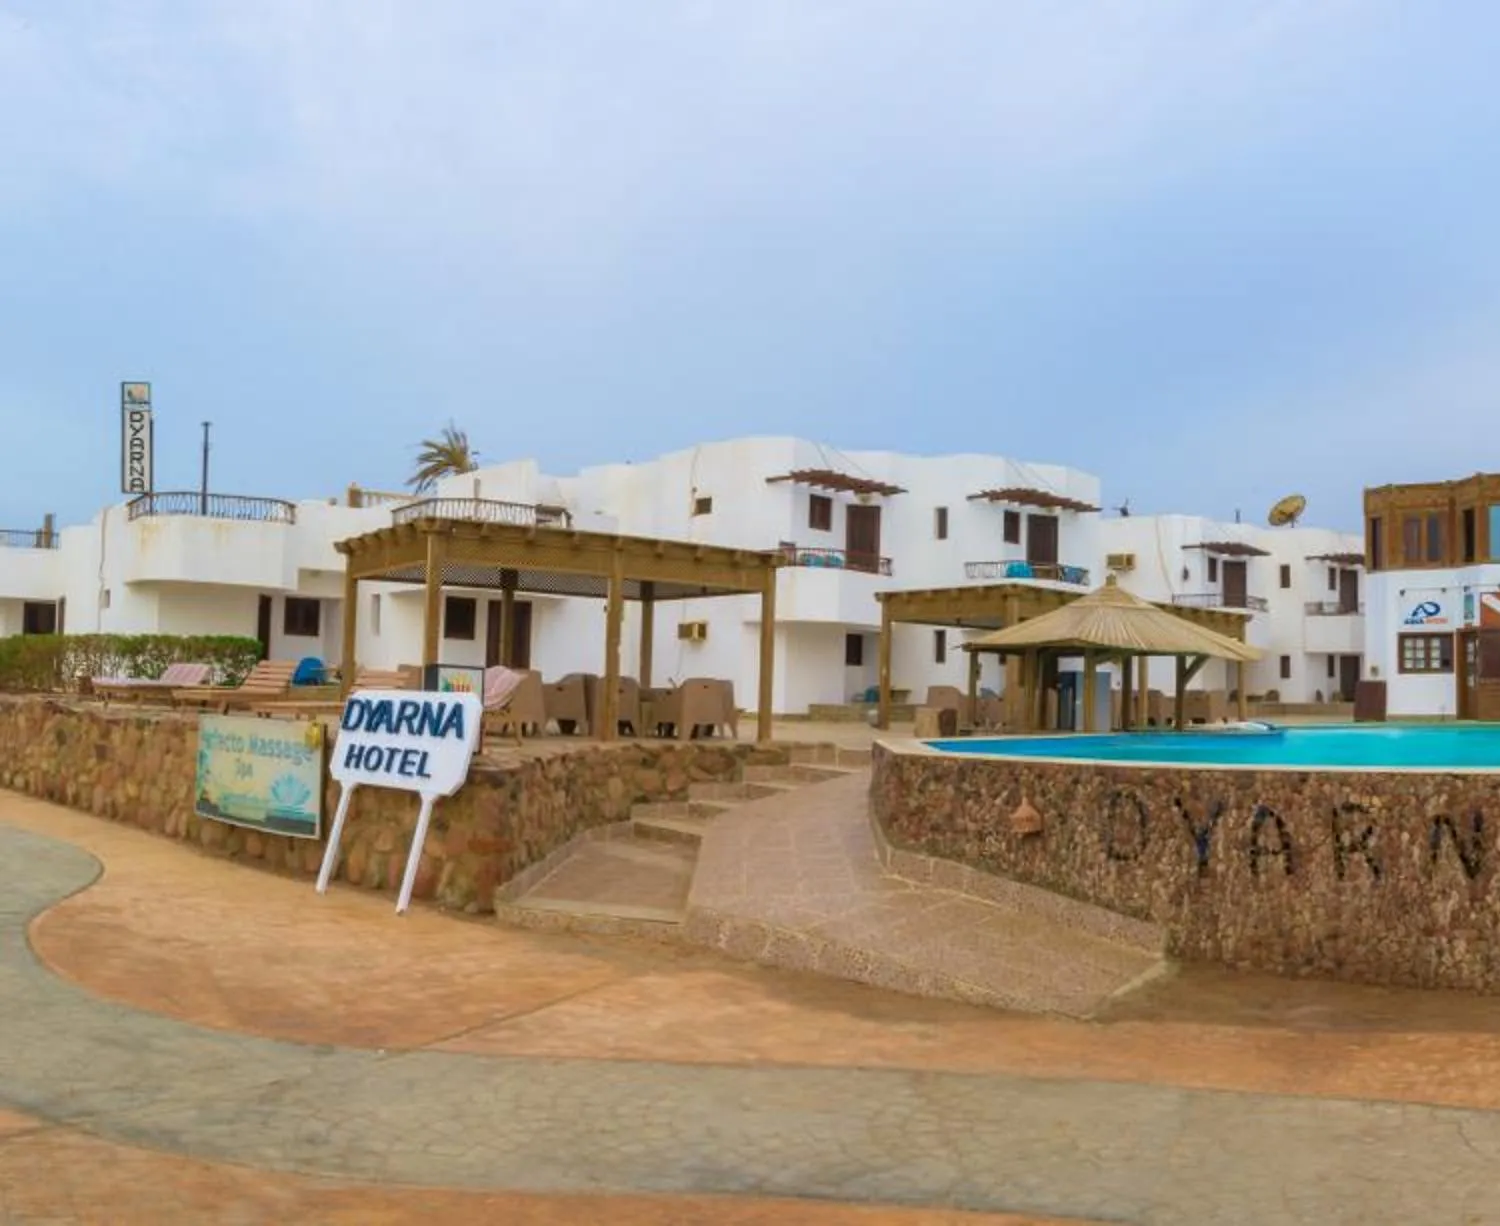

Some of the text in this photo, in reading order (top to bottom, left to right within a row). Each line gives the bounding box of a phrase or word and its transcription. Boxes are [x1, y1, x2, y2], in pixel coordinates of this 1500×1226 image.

[129, 411, 145, 491] DYARNA
[342, 698, 465, 740] DYARNA
[344, 743, 431, 779] HOTEL
